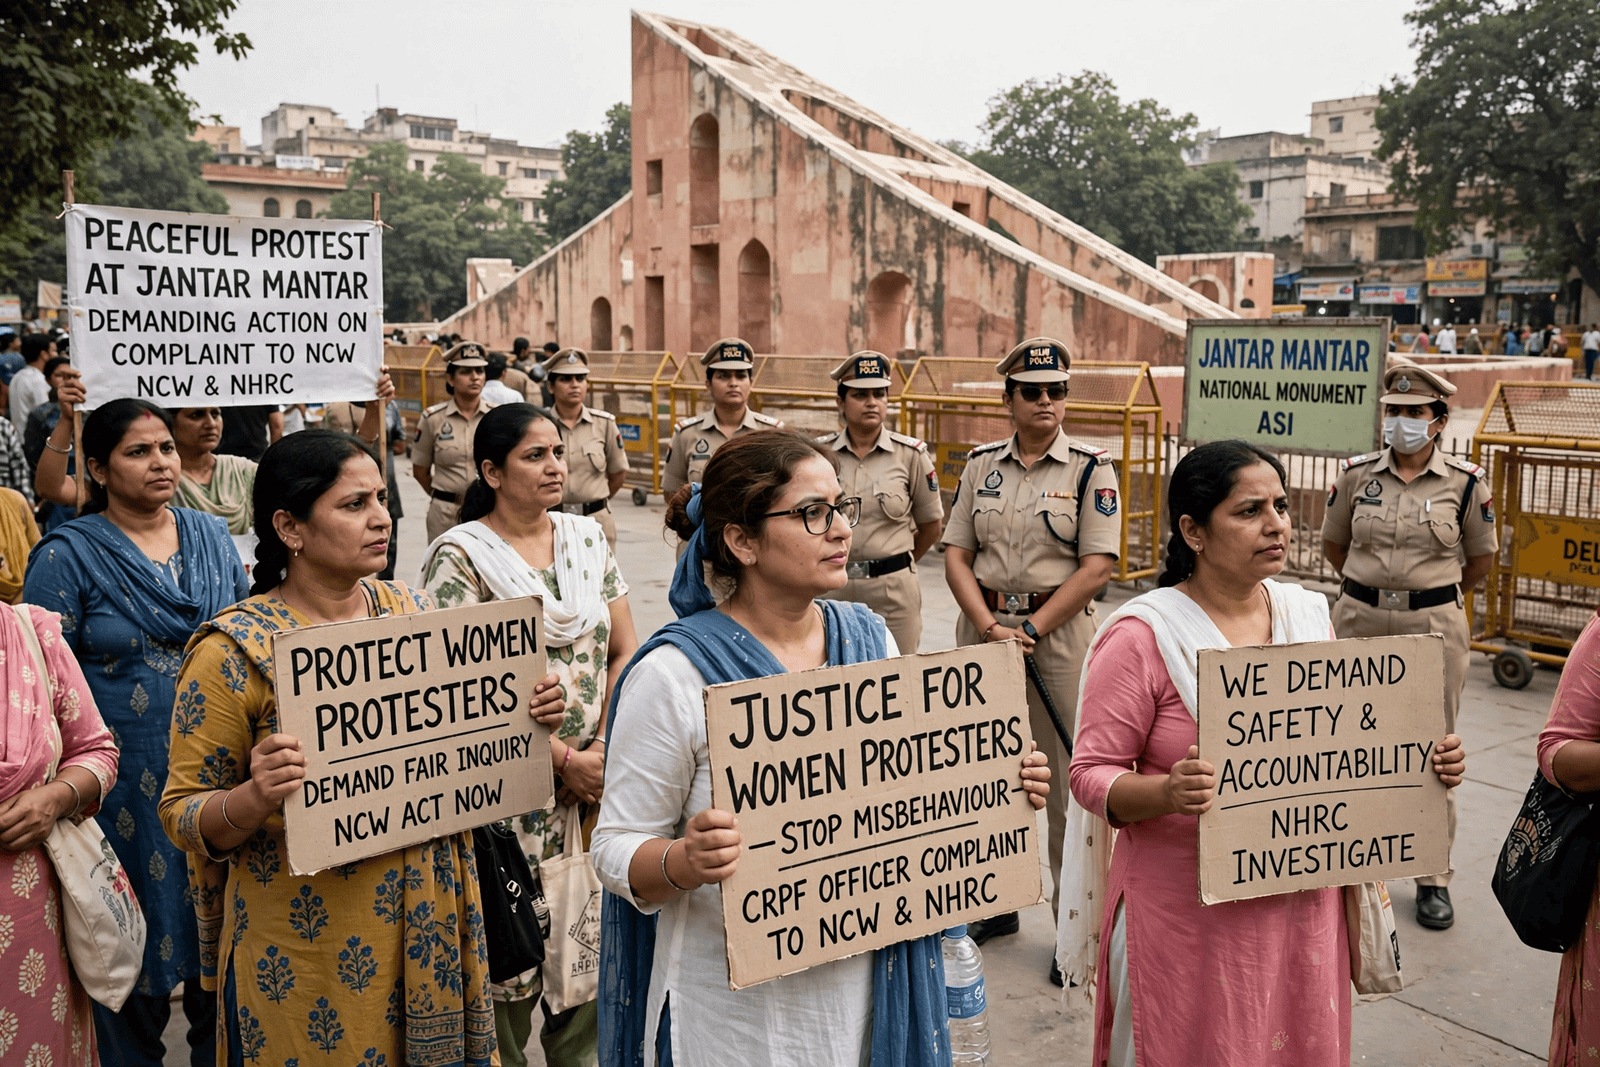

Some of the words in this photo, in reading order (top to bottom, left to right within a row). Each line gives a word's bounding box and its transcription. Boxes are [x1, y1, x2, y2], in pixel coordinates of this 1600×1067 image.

[85, 218, 238, 256] PEACEFUL
[252, 228, 369, 260] PROTEST
[85, 263, 124, 294] AT
[137, 265, 250, 298] JANTAR
[263, 270, 368, 299] MANTAR
[89, 309, 235, 332] DEMANDING
[248, 312, 327, 332] ACTION
[338, 312, 366, 332] ON
[112, 343, 255, 365] COMPLAINT
[266, 343, 294, 363] TO
[307, 343, 355, 363] NCW
[1029, 356, 1053, 365] POLICE
[1199, 339, 1274, 369] JANTAR
[1281, 339, 1369, 372] MANTAR
[138, 376, 193, 397] NCW
[205, 376, 218, 395] &
[231, 373, 293, 395] NHRC
[1200, 380, 1270, 400] NATIONAL
[1277, 382, 1366, 404] MONUMENT
[1257, 411, 1293, 435] ASI
[291, 632, 432, 697] PROTECT
[442, 617, 536, 667] WOMEN
[1220, 663, 1268, 698] WE
[1288, 655, 1405, 693] DEMAND
[316, 672, 517, 751] PROTESTERS
[729, 673, 902, 749] JUSTICE
[923, 662, 986, 713] FOR
[1227, 705, 1343, 746] SAFETY
[1360, 703, 1376, 730] &
[304, 765, 394, 808] DEMAND
[405, 752, 448, 784] FAIR
[458, 733, 532, 771] INQUIRY
[726, 748, 846, 813] WOMEN
[862, 716, 1023, 786] PROTESTERS
[1218, 741, 1433, 795] ACCOUNTABILITY
[335, 807, 389, 846] NCW
[402, 793, 443, 829] ACT
[456, 779, 502, 815] NOW
[1272, 803, 1348, 838] NHRC
[743, 879, 807, 923] CRPF
[819, 857, 910, 903] OFFICER
[921, 827, 1029, 876] COMPLAINT
[1233, 833, 1414, 884] INVESTIGATE
[767, 926, 803, 960] TO
[820, 903, 879, 947] NCW
[895, 896, 912, 925] &
[926, 873, 998, 919] NHRC
